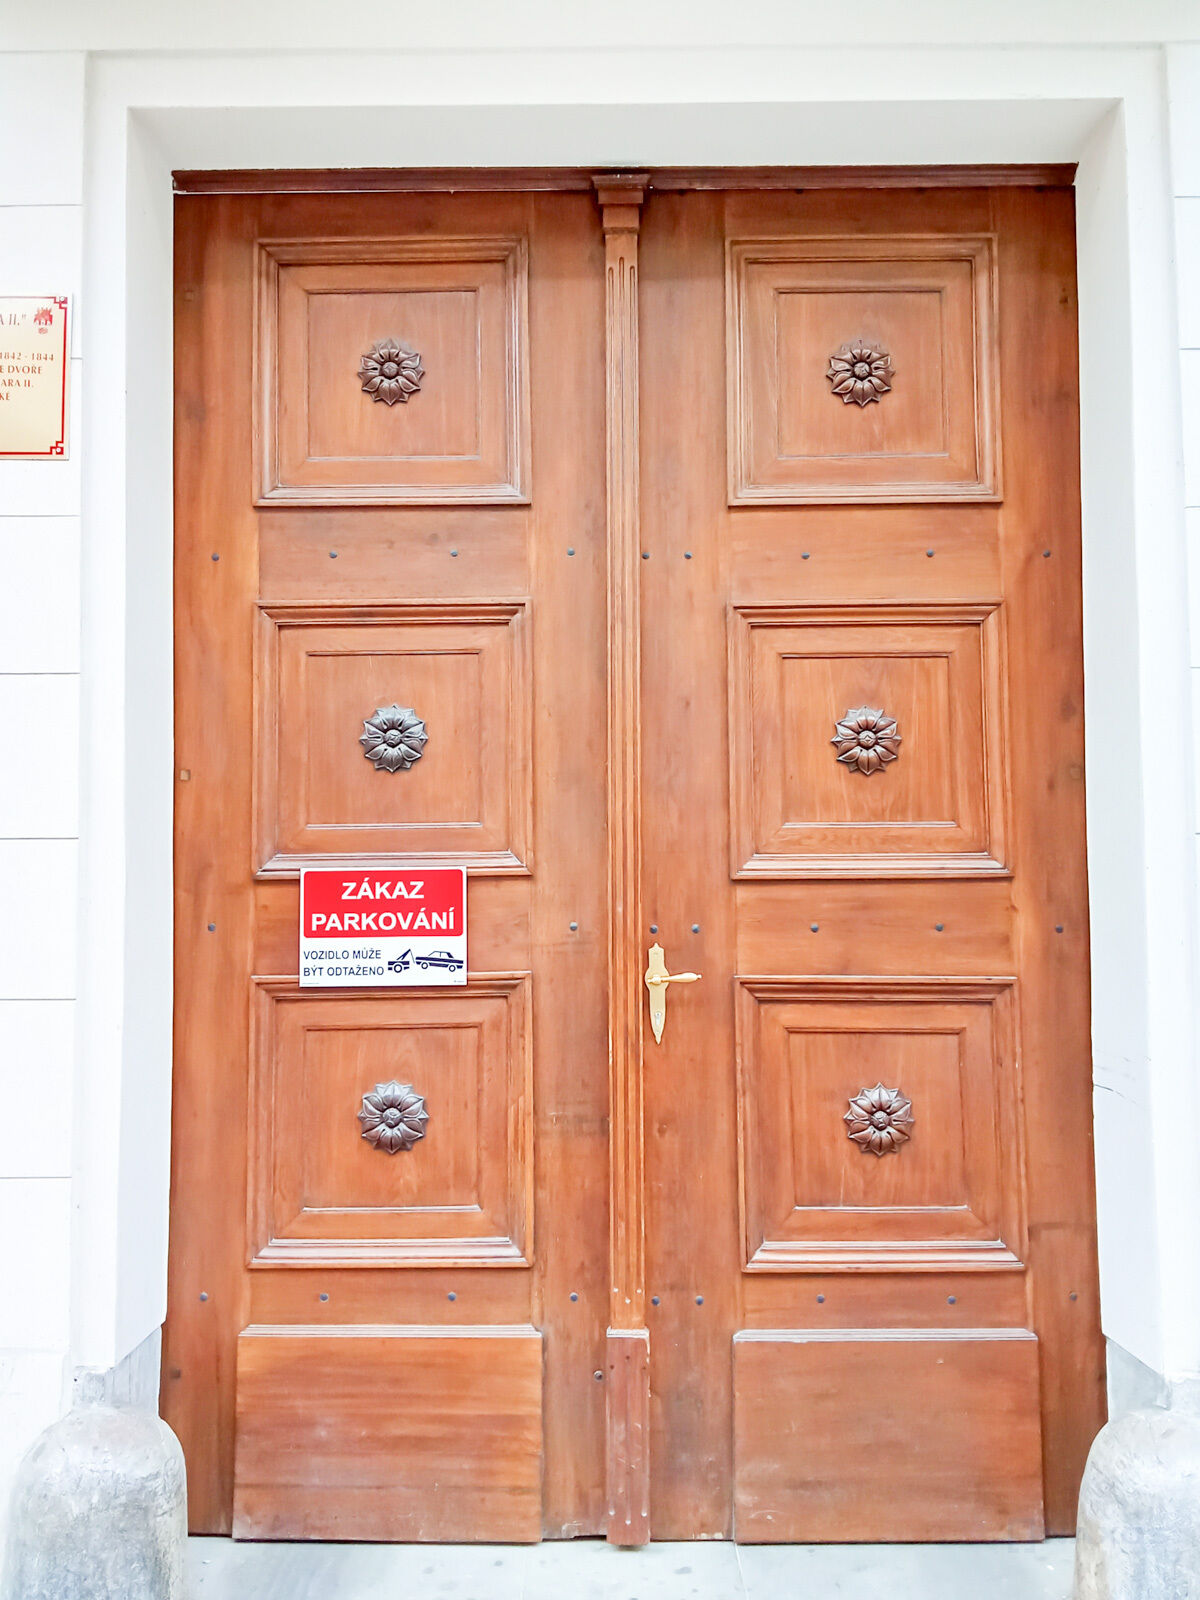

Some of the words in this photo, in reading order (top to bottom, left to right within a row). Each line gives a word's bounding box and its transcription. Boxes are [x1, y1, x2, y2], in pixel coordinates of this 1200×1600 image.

[31, 352, 54, 361] 1844
[341, 877, 425, 900] ZÁKAZ
[311, 907, 455, 932] PARKOVÁNÍ
[303, 950, 350, 960] VOZIDLO
[352, 947, 382, 960] MŮŽE
[303, 965, 324, 977] BÝT
[327, 965, 385, 976] ODTAŽENO
